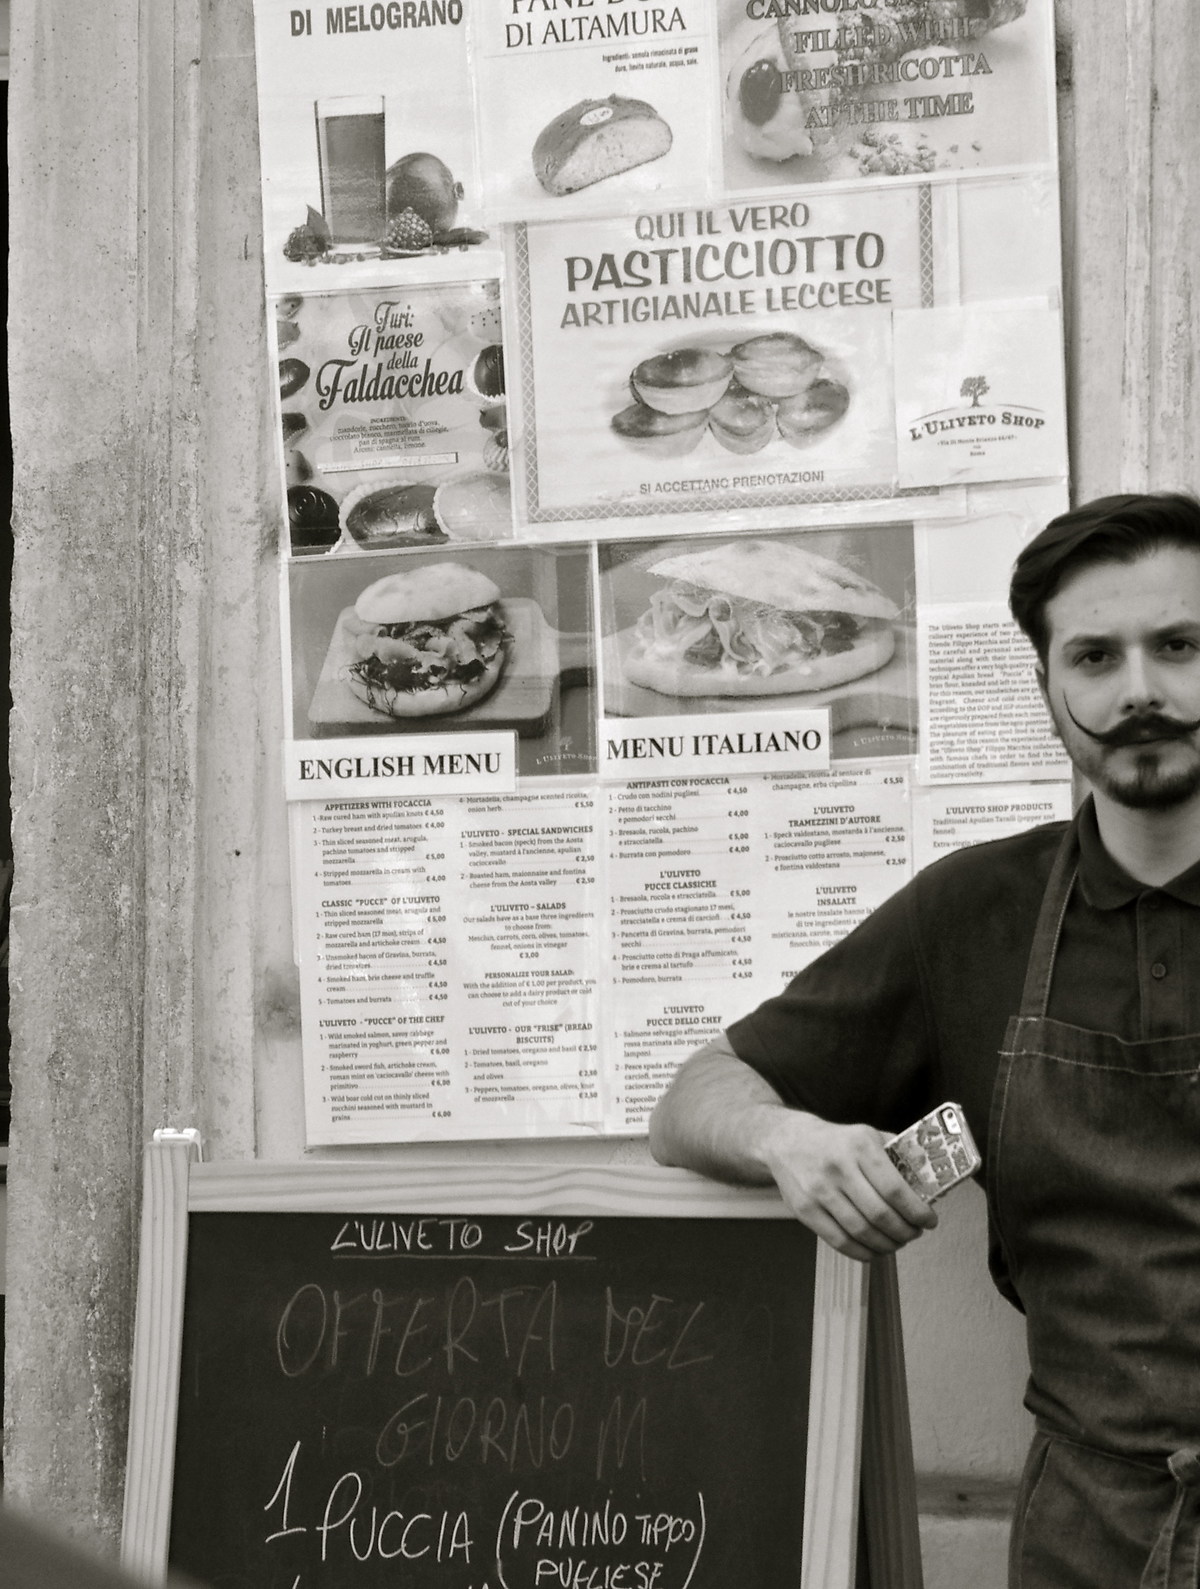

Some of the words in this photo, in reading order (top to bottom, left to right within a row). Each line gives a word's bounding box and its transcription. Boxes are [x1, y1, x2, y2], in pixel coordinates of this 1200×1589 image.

[290, 10, 312, 36] DI
[327, 0, 463, 35] MELOGRANO
[506, 23, 532, 48] DI
[542, 7, 686, 45] ALTAMURA
[793, 23, 891, 53] FILLED
[900, 17, 972, 42] WITH
[781, 63, 868, 93] FRESH
[869, 53, 993, 84] RICOTTA
[804, 103, 841, 129] AT
[841, 99, 898, 125] THE
[904, 92, 974, 120] TIME
[635, 211, 685, 242] QUI
[696, 210, 722, 236] IL
[729, 202, 810, 232] VERO
[564, 232, 885, 292] PASTICCIOTTO
[560, 289, 755, 329] ARTIGIANALE
[766, 278, 893, 312] LECCESE
[374, 301, 414, 334] Turi:
[348, 325, 371, 356] Il
[373, 332, 424, 357] paese
[387, 351, 419, 370] della
[315, 358, 464, 411] Faldacchea
[1002, 411, 1045, 429] SHOP
[639, 483, 651, 495] SI
[655, 478, 729, 494] ACCETTANO
[733, 470, 824, 488] PRENOTAZIONI
[607, 736, 685, 759] MENU
[692, 729, 822, 756] ITALIANO
[300, 755, 414, 780] ENGLISH
[423, 752, 501, 775] MENU
[627, 780, 669, 789] ANTIPASTI
[672, 779, 687, 787] CON
[690, 777, 729, 786] FOCACCIA
[371, 801, 392, 809] WITH
[394, 800, 432, 808] FOCACCIA
[814, 805, 855, 814] L'ULIVETO
[946, 806, 985, 815] L'ULIVETO
[1011, 803, 1053, 811] PRODUCTS
[789, 818, 838, 827] TRAMEZZINI
[840, 816, 881, 824] D'AUTORE
[461, 830, 500, 838] L'ULIVETO
[508, 828, 539, 836] SPECIAL
[541, 826, 593, 834] SANDWICHES
[660, 870, 701, 878] L'ULIVETO
[645, 882, 671, 891] PUCCE
[673, 880, 717, 889] CLASSICHE
[816, 886, 857, 895] L'ULIVETO
[322, 900, 352, 908] CLASSIC
[491, 904, 529, 912] L'ULIVETO
[817, 898, 856, 906] INSALATE
[485, 971, 529, 979] PERSONALIZE
[664, 1005, 704, 1014] L'ULIVETO
[320, 1019, 356, 1027] L'ULIVETO
[409, 1016, 424, 1024] THE
[469, 1026, 507, 1035] L'ULIVETO
[565, 1023, 592, 1032] (BREAD
[647, 1018, 673, 1026] PUCCE
[701, 1016, 722, 1024] CHEF
[516, 1036, 554, 1044] BISCUITS)
[504, 1221, 593, 1257] SHOP
[277, 1276, 558, 1377] OFFERTA
[376, 1392, 574, 1473] GIORNO
[315, 1471, 474, 1564] PUCCIA
